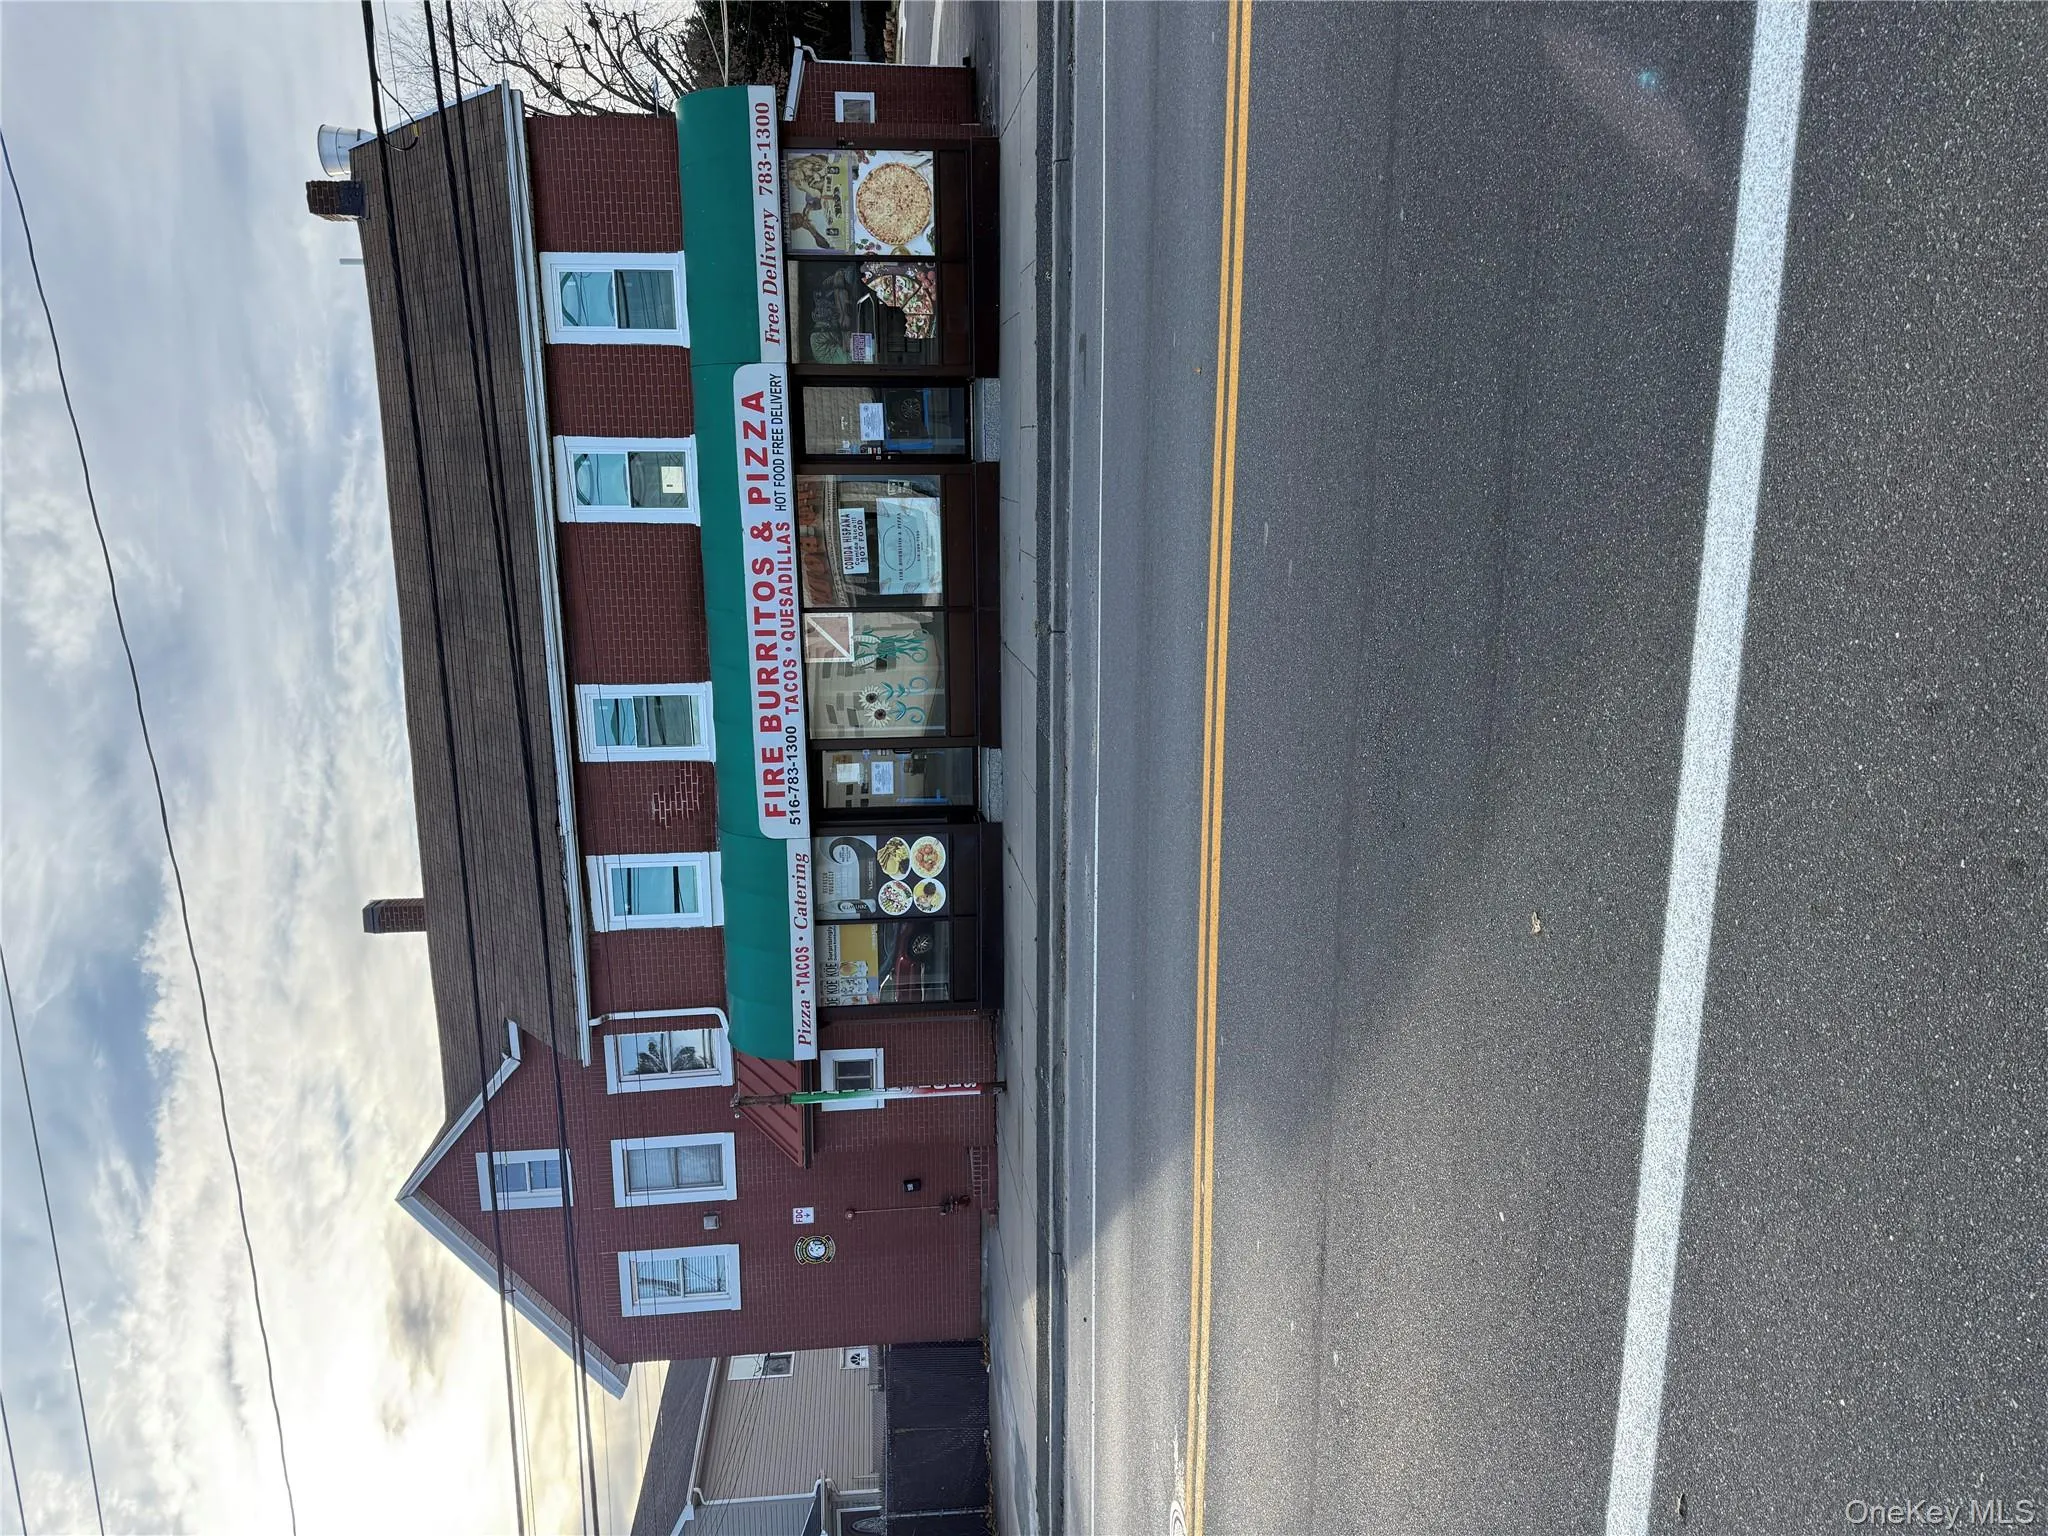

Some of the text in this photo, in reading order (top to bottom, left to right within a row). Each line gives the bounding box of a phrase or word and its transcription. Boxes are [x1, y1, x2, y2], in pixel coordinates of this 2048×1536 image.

[780, 159, 788, 180] DELI
[754, 102, 781, 345] Free Delivery 783-1300
[782, 201, 791, 244] PIZZERIA
[769, 373, 787, 512] HOT FOOD FREE DELIVERY
[840, 513, 855, 570] COMIDA HISPANA
[857, 519, 867, 563] HOT FOOD
[741, 390, 787, 818] FIRE BURRITOS & PIZZA
[775, 521, 800, 715] TACOS QUESADILLAS
[784, 725, 801, 825] 516-783-1300
[791, 852, 812, 1046] Pizza TACOS Catering
[795, 1209, 803, 1223] FDC
